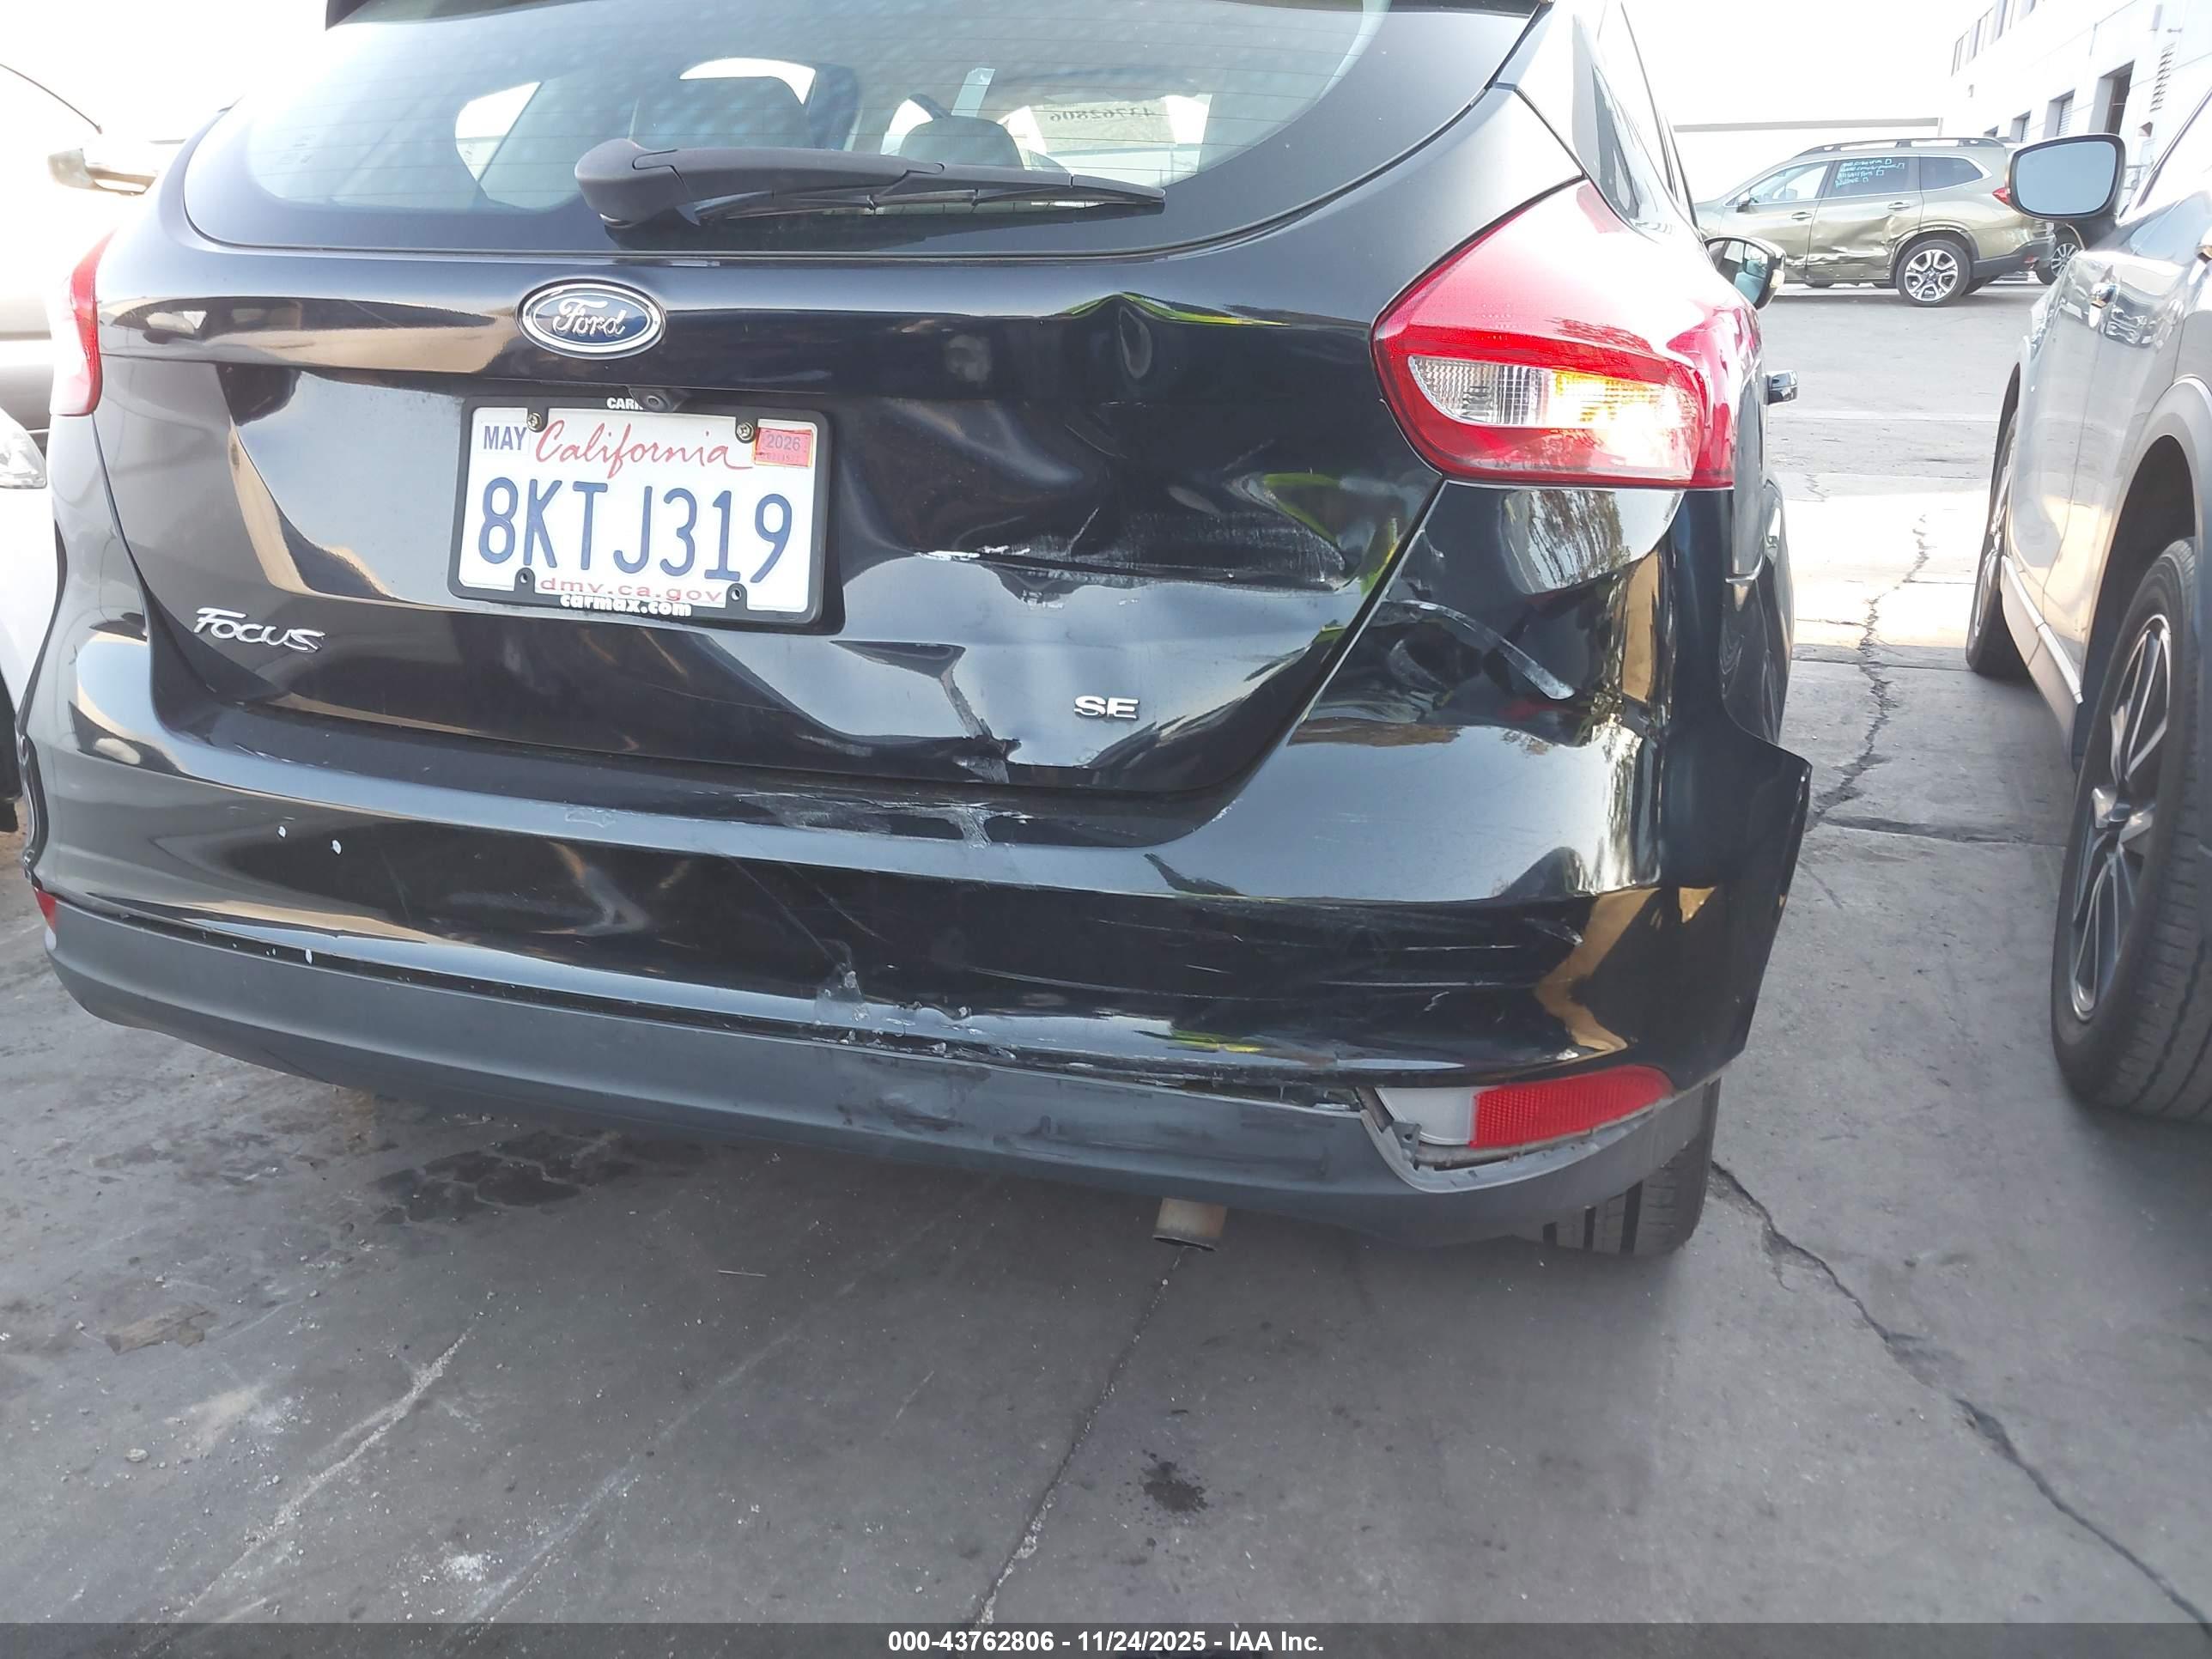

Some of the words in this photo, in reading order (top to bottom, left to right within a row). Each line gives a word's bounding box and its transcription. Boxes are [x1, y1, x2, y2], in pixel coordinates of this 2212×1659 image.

[552, 297, 628, 337] Ford
[483, 425, 528, 451] MAY
[535, 420, 754, 479] California
[767, 433, 801, 452] 2026
[478, 477, 793, 584] 8KTJ319
[539, 578, 723, 602] dmv.ca.gov
[560, 593, 692, 617] carmax.com
[1073, 695, 1140, 720] SE
